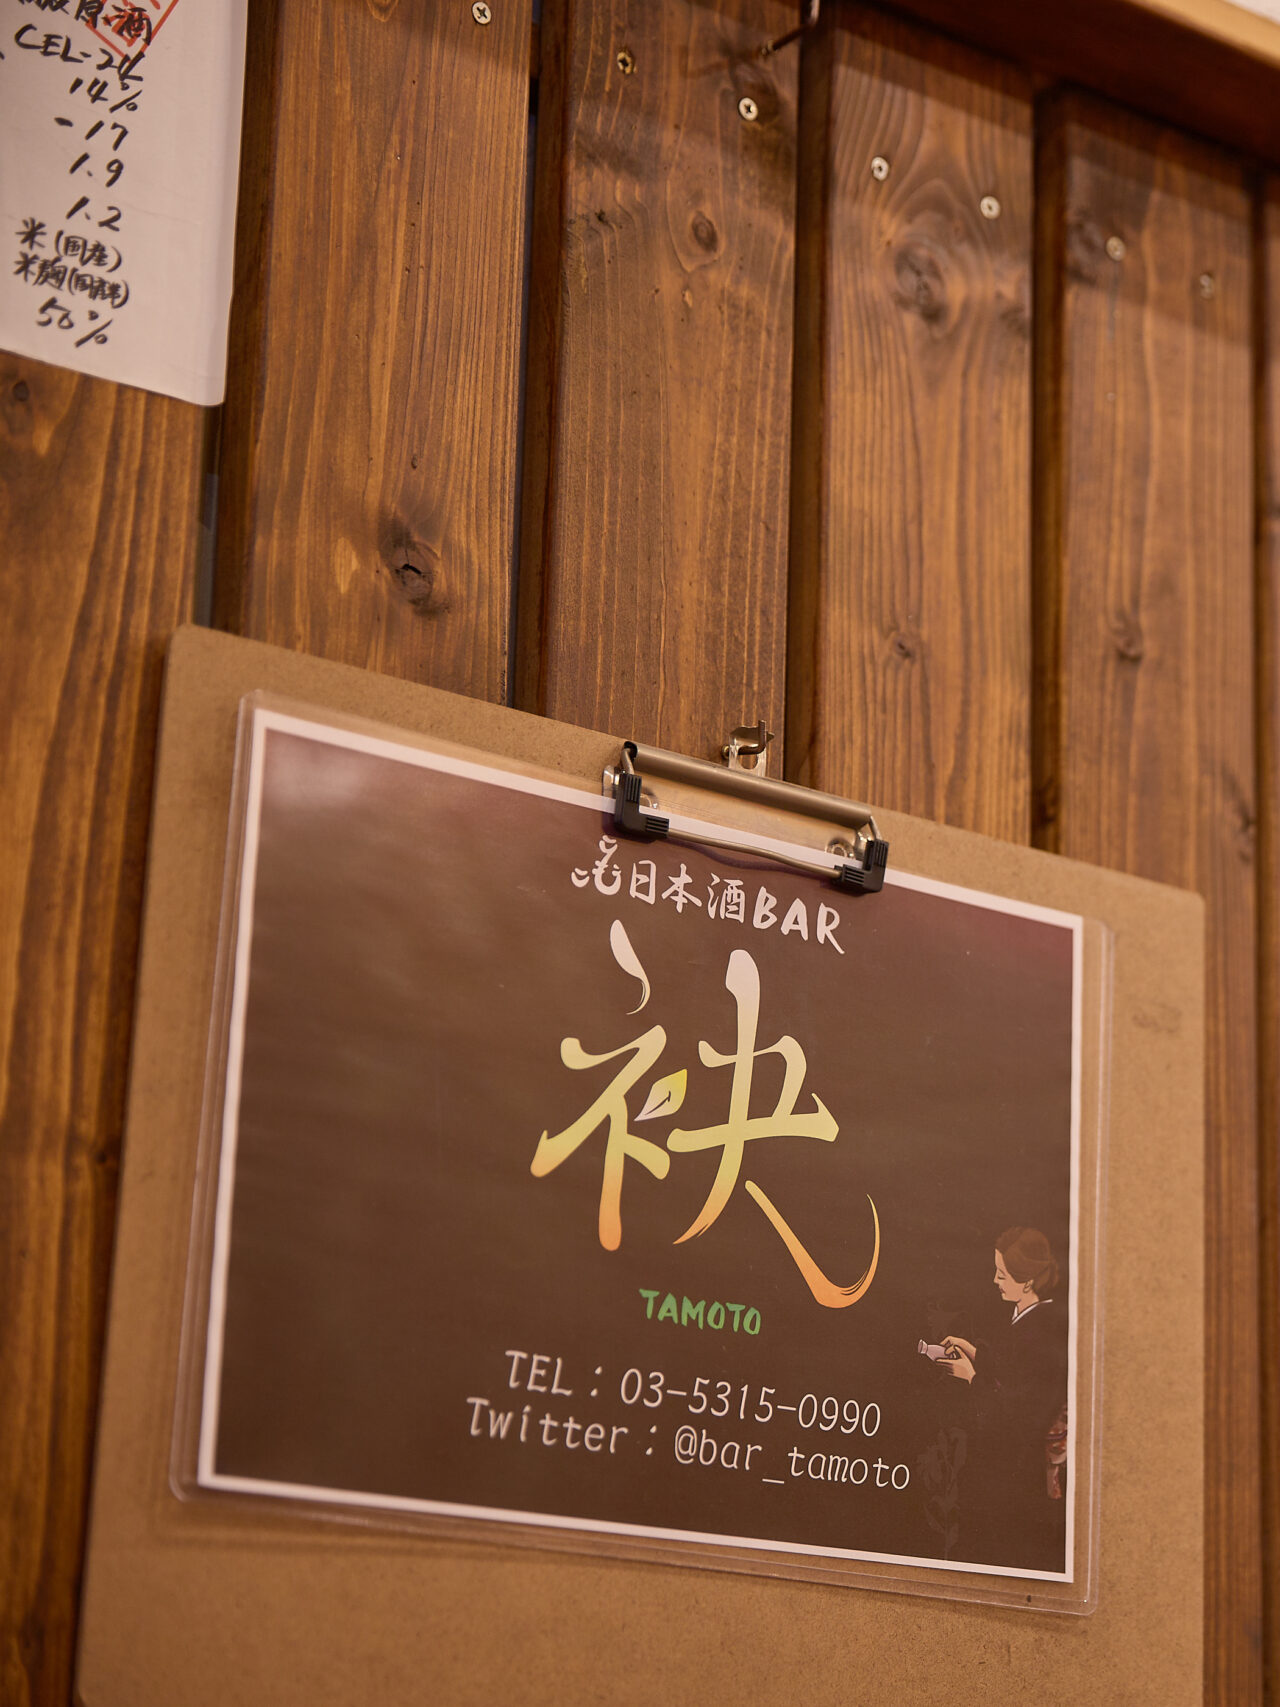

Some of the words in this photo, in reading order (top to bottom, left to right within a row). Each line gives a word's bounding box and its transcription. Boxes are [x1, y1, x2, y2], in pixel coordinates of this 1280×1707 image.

[70, 77, 142, 113] 14%
[69, 152, 124, 188] 1.9
[65, 196, 122, 232] 1.2
[530, 919, 881, 1309] 袂
[639, 1288, 762, 1336] TAMOTO
[619, 1368, 882, 1437] 03-5315-0990
[674, 1426, 911, 1491] @bar_tamoto
